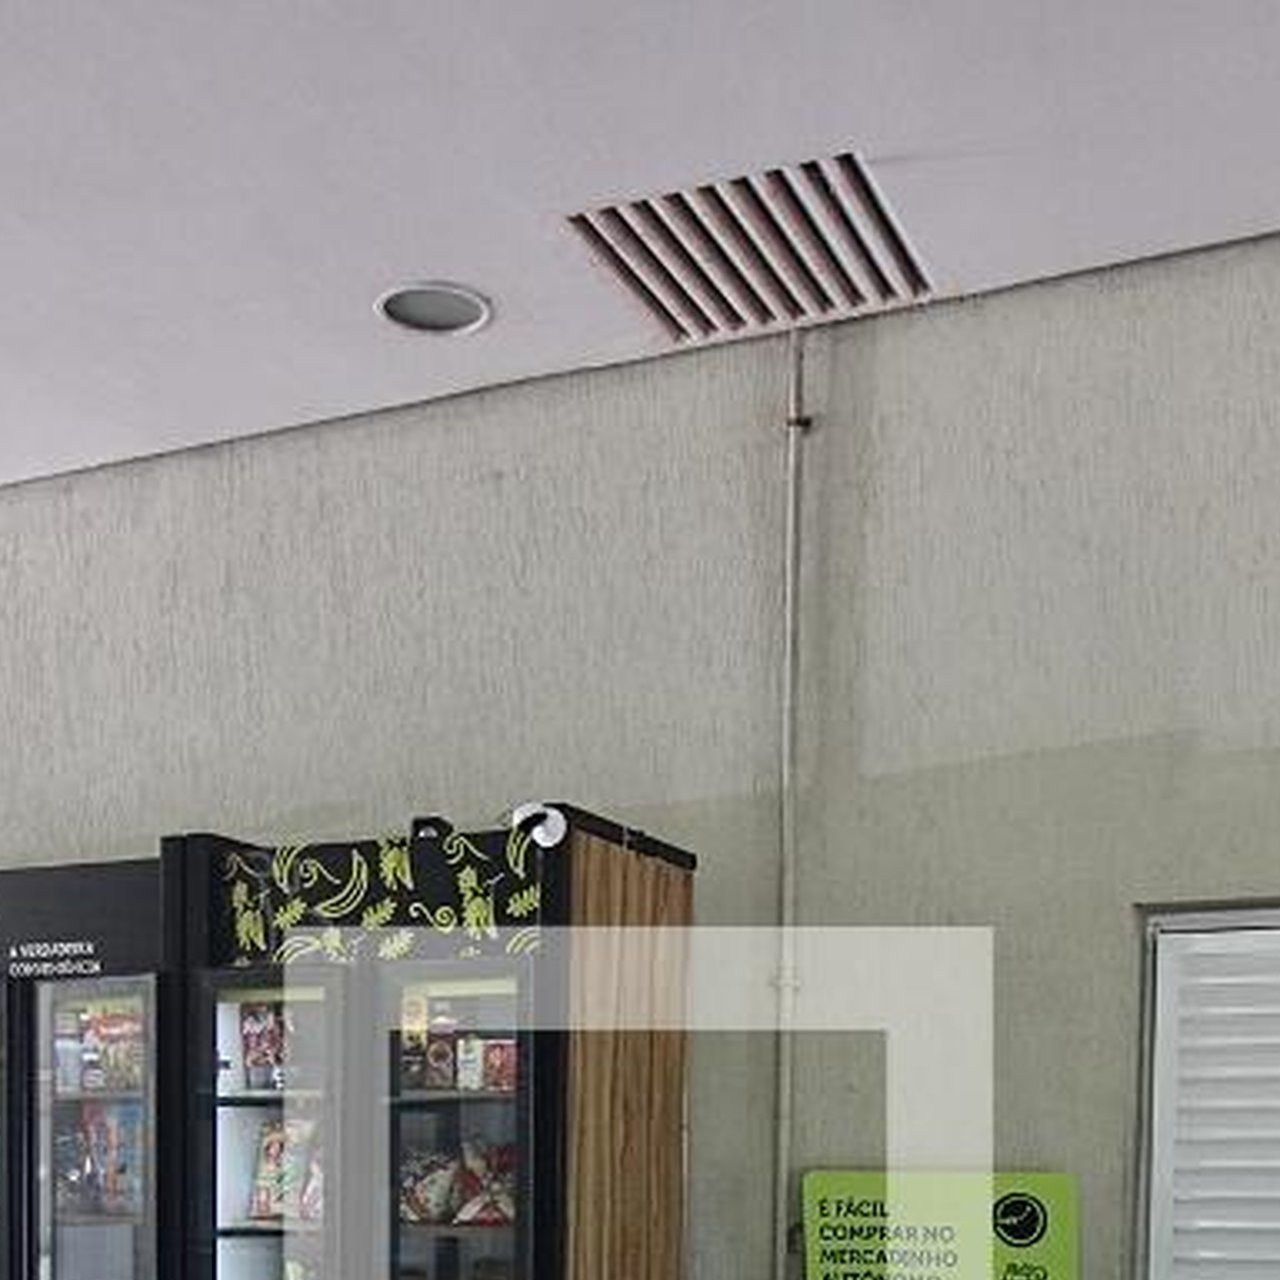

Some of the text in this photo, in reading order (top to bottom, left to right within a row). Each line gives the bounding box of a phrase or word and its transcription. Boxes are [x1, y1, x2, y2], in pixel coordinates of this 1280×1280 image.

[819, 1196, 888, 1218] É FÁCIL
[819, 1224, 955, 1242] COMPRAR NO
[820, 1249, 958, 1267] MERCADINHO
